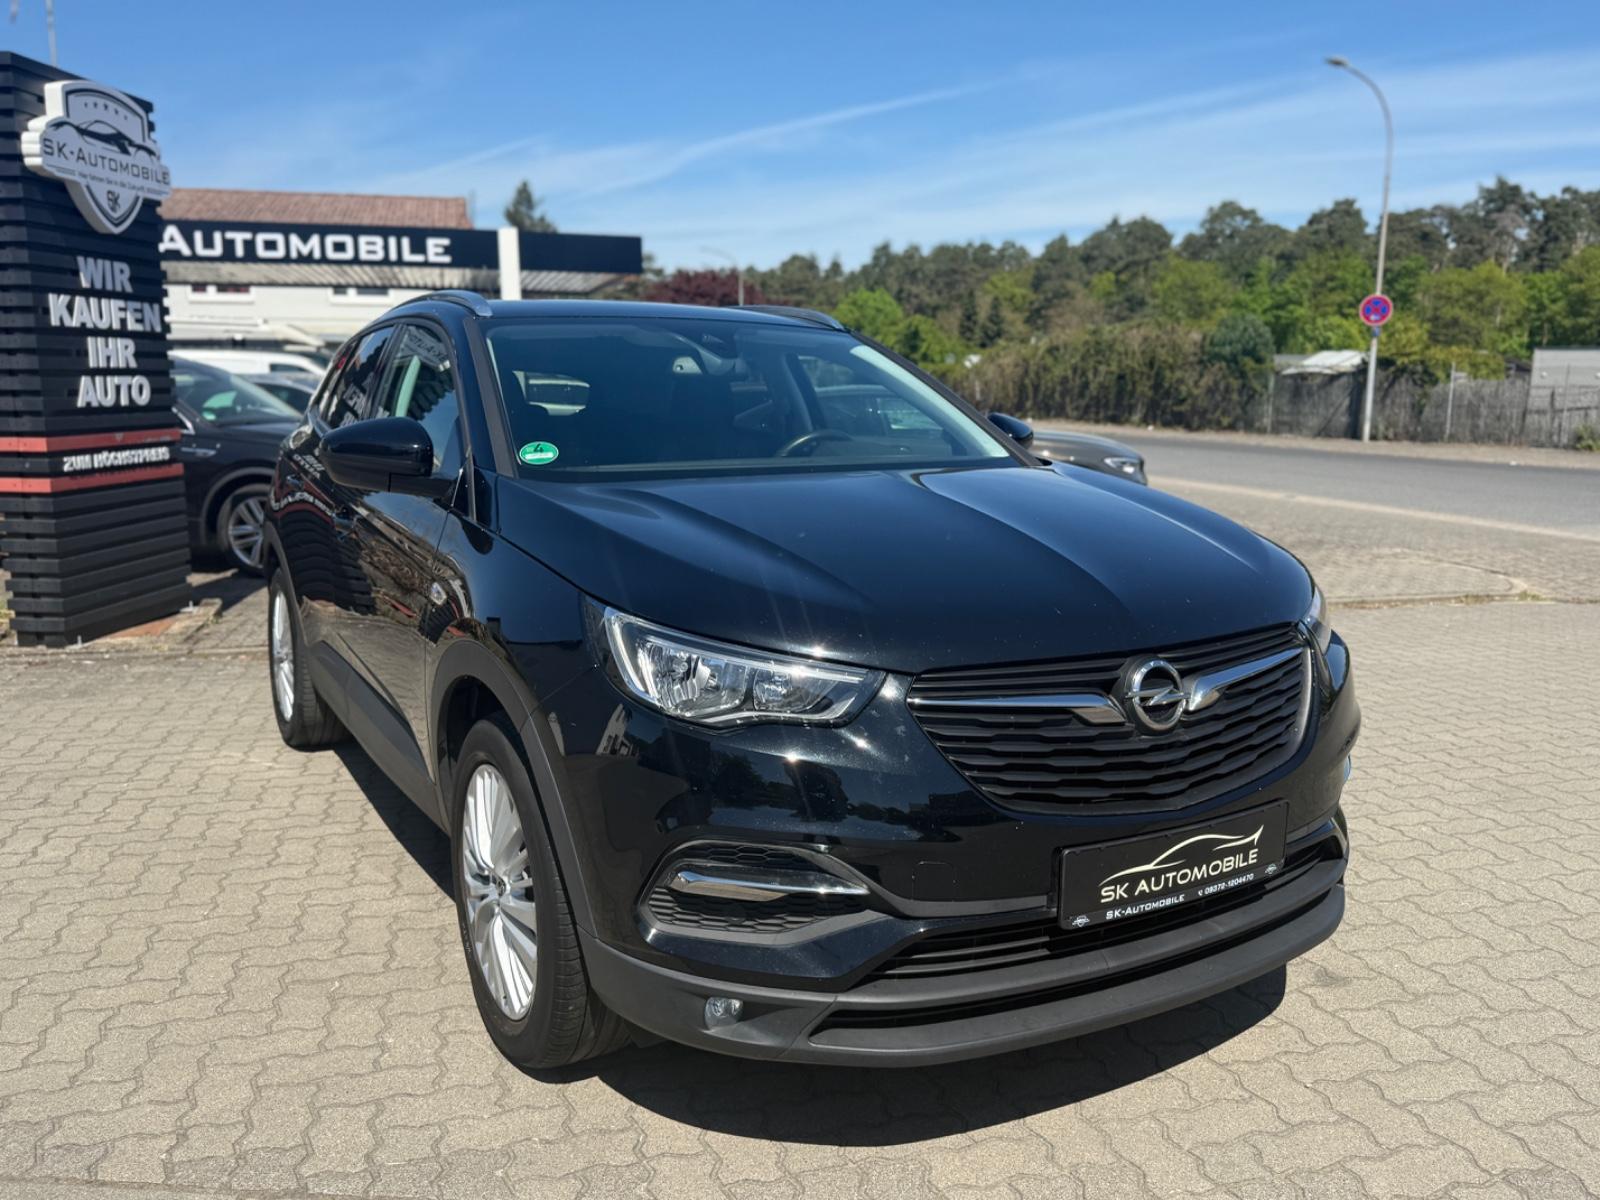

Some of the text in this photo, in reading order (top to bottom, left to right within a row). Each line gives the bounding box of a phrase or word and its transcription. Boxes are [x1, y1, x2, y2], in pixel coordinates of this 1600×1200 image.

[43, 137, 170, 185] SK-AUTOMOBILE
[158, 224, 452, 264] AUTOMOBILE
[76, 255, 133, 293] WIR
[48, 293, 162, 333] KAUFEN
[86, 336, 137, 369] IHR
[76, 375, 151, 408] AUTO
[63, 454, 92, 472] ZUM
[1100, 848, 1259, 904] SK AUTOMOBILE
[1105, 894, 1186, 921] SK-AUTOMOBILE
